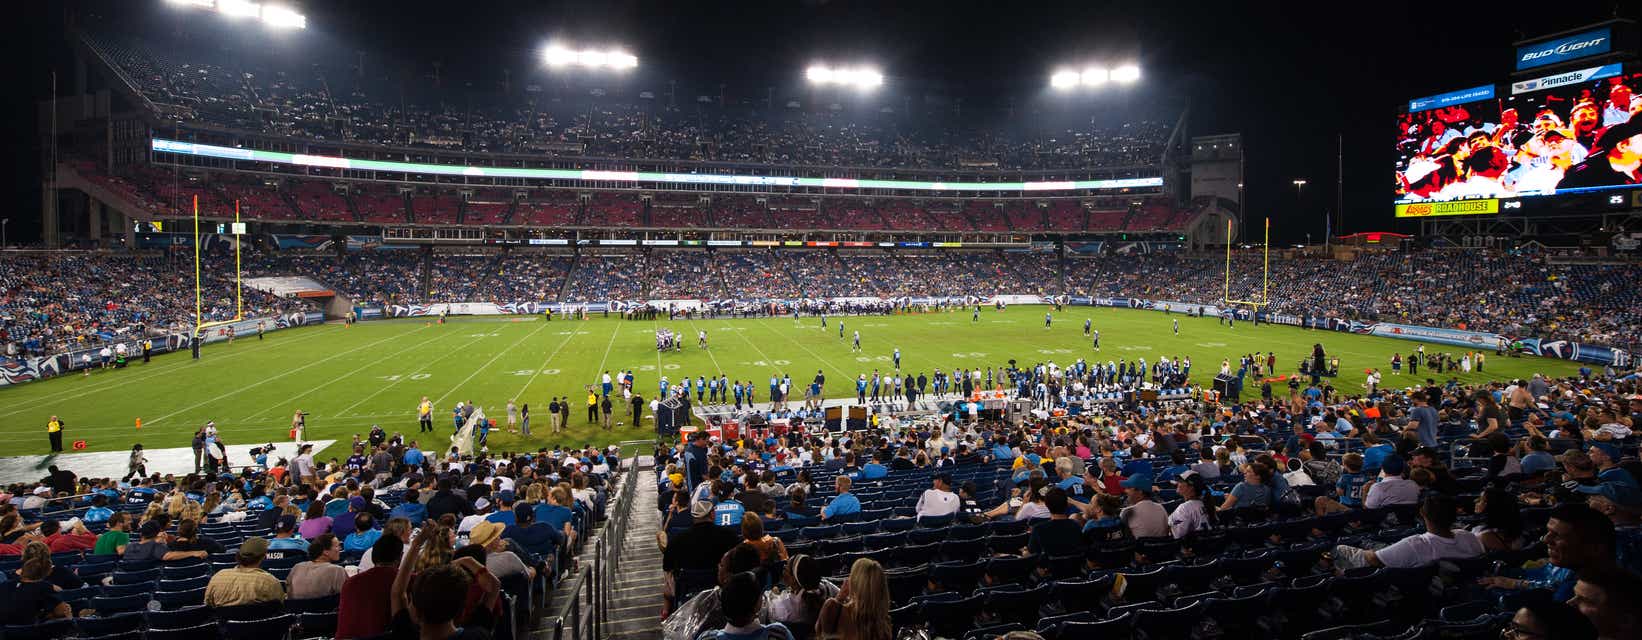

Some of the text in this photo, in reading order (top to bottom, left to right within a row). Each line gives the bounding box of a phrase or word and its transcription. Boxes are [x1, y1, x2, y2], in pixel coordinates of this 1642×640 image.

[1521, 38, 1606, 61] BUD LIGHT
[1541, 73, 1582, 86] Pinnacle
[1434, 201, 1488, 213] ROADHOUSE
